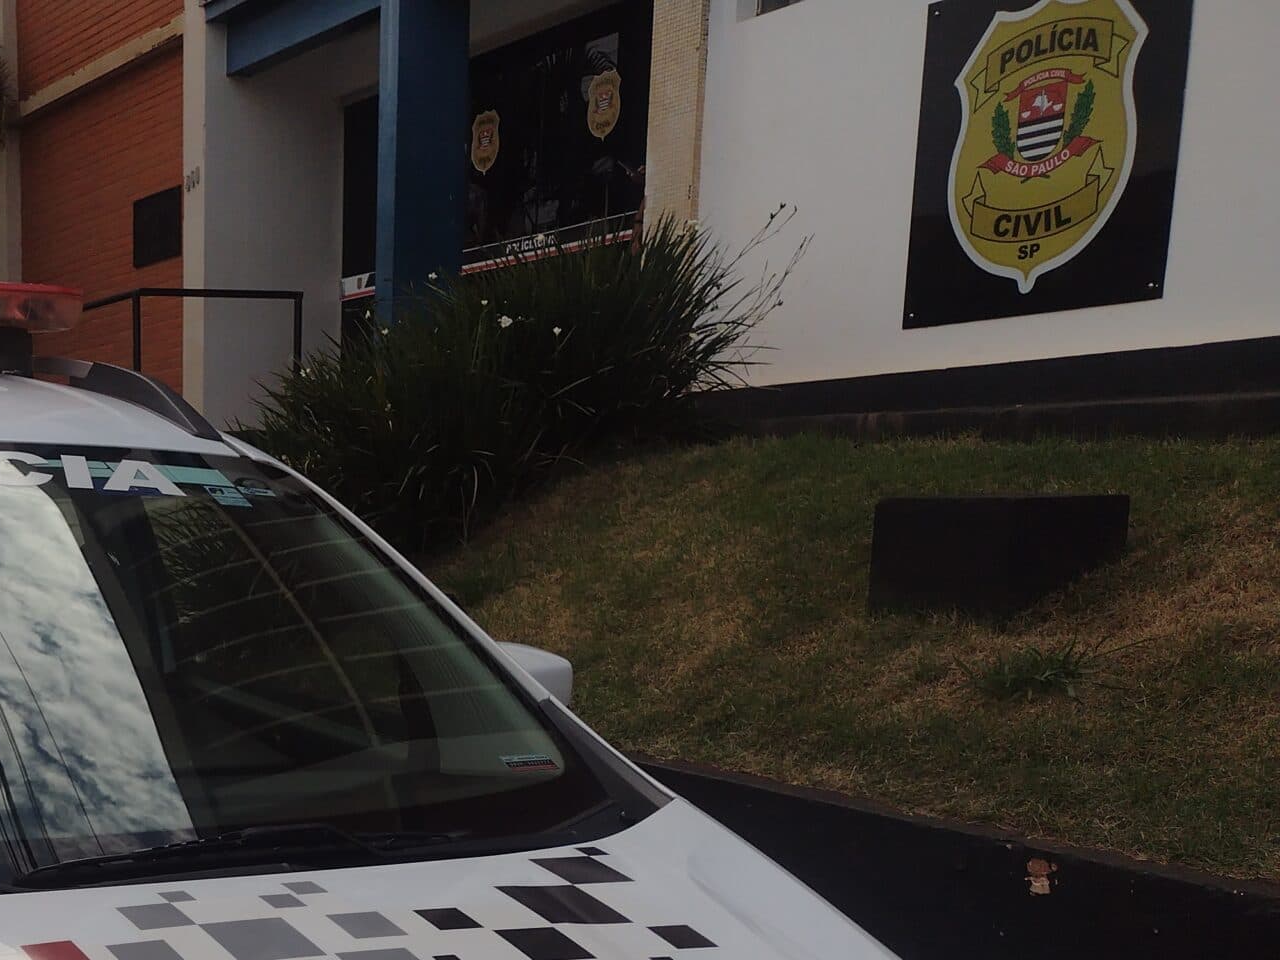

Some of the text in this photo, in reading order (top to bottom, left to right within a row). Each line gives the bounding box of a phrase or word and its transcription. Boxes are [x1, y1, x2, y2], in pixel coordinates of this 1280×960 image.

[999, 24, 1099, 73] POLÍCIA
[1031, 149, 1070, 176] PAULO
[993, 205, 1071, 238] CIVIL
[1017, 243, 1041, 260] SP
